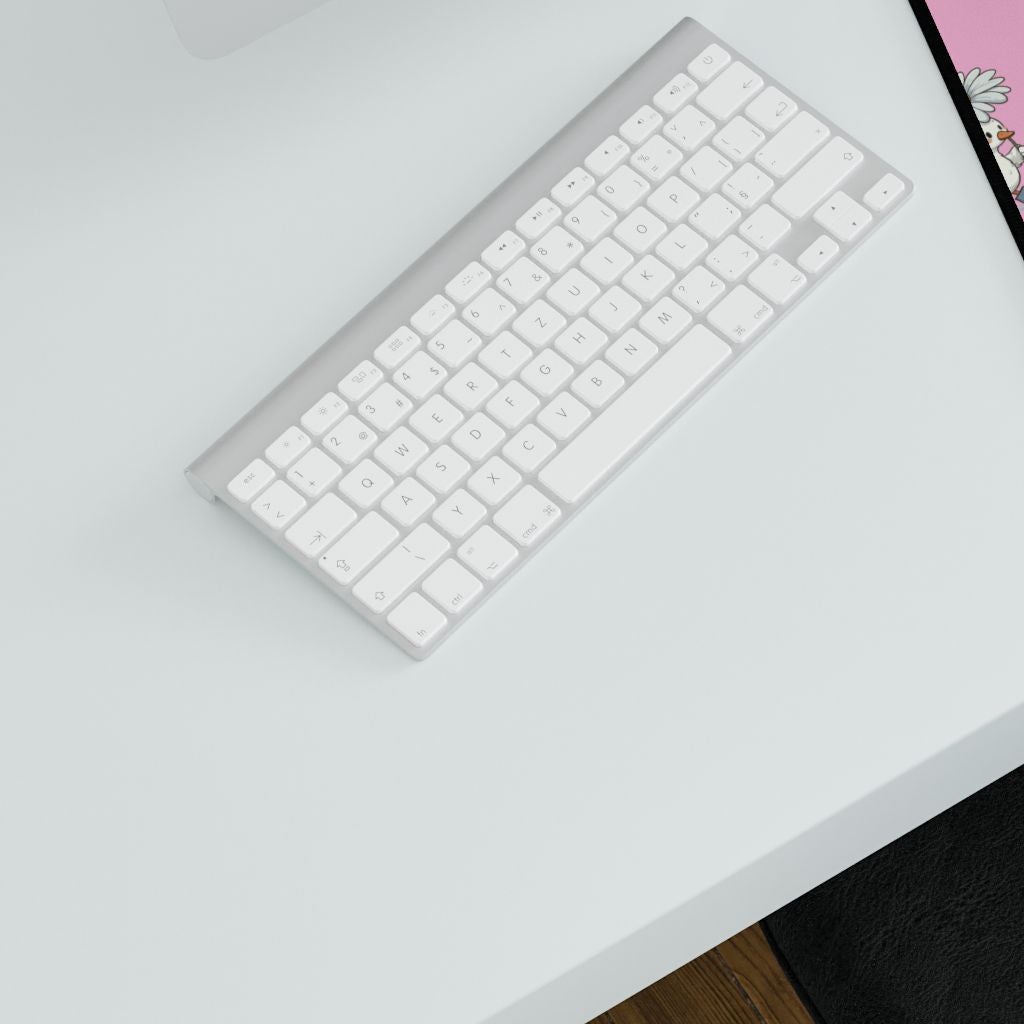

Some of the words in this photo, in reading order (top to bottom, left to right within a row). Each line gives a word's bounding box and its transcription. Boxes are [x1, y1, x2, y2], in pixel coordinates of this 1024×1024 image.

[329, 436, 342, 447] 2
[365, 404, 376, 415] 3
[401, 371, 412, 382] 4
[435, 340, 446, 351] 5
[470, 309, 480, 319] 6
[502, 277, 513, 288] 7
[537, 247, 548, 256] 8
[570, 216, 581, 225] 9
[360, 477, 375, 489] Q
[393, 443, 410, 457] W
[431, 412, 444, 424] E
[465, 380, 479, 392] R
[499, 348, 512, 359] T
[534, 316, 548, 329] Z
[567, 284, 581, 297] U
[668, 193, 679, 204] P
[400, 495, 414, 507] A
[435, 461, 447, 472] S
[469, 429, 482, 441] D
[504, 396, 515, 408] F
[539, 363, 552, 375] G
[571, 331, 587, 345] H
[608, 301, 619, 312] J
[639, 269, 654, 281] K
[674, 241, 687, 250] L
[450, 504, 464, 516] Y
[486, 471, 502, 486] X
[521, 440, 535, 452] C
[555, 407, 568, 418] V
[590, 376, 603, 388] B
[623, 343, 638, 356] N
[657, 311, 673, 326] M
